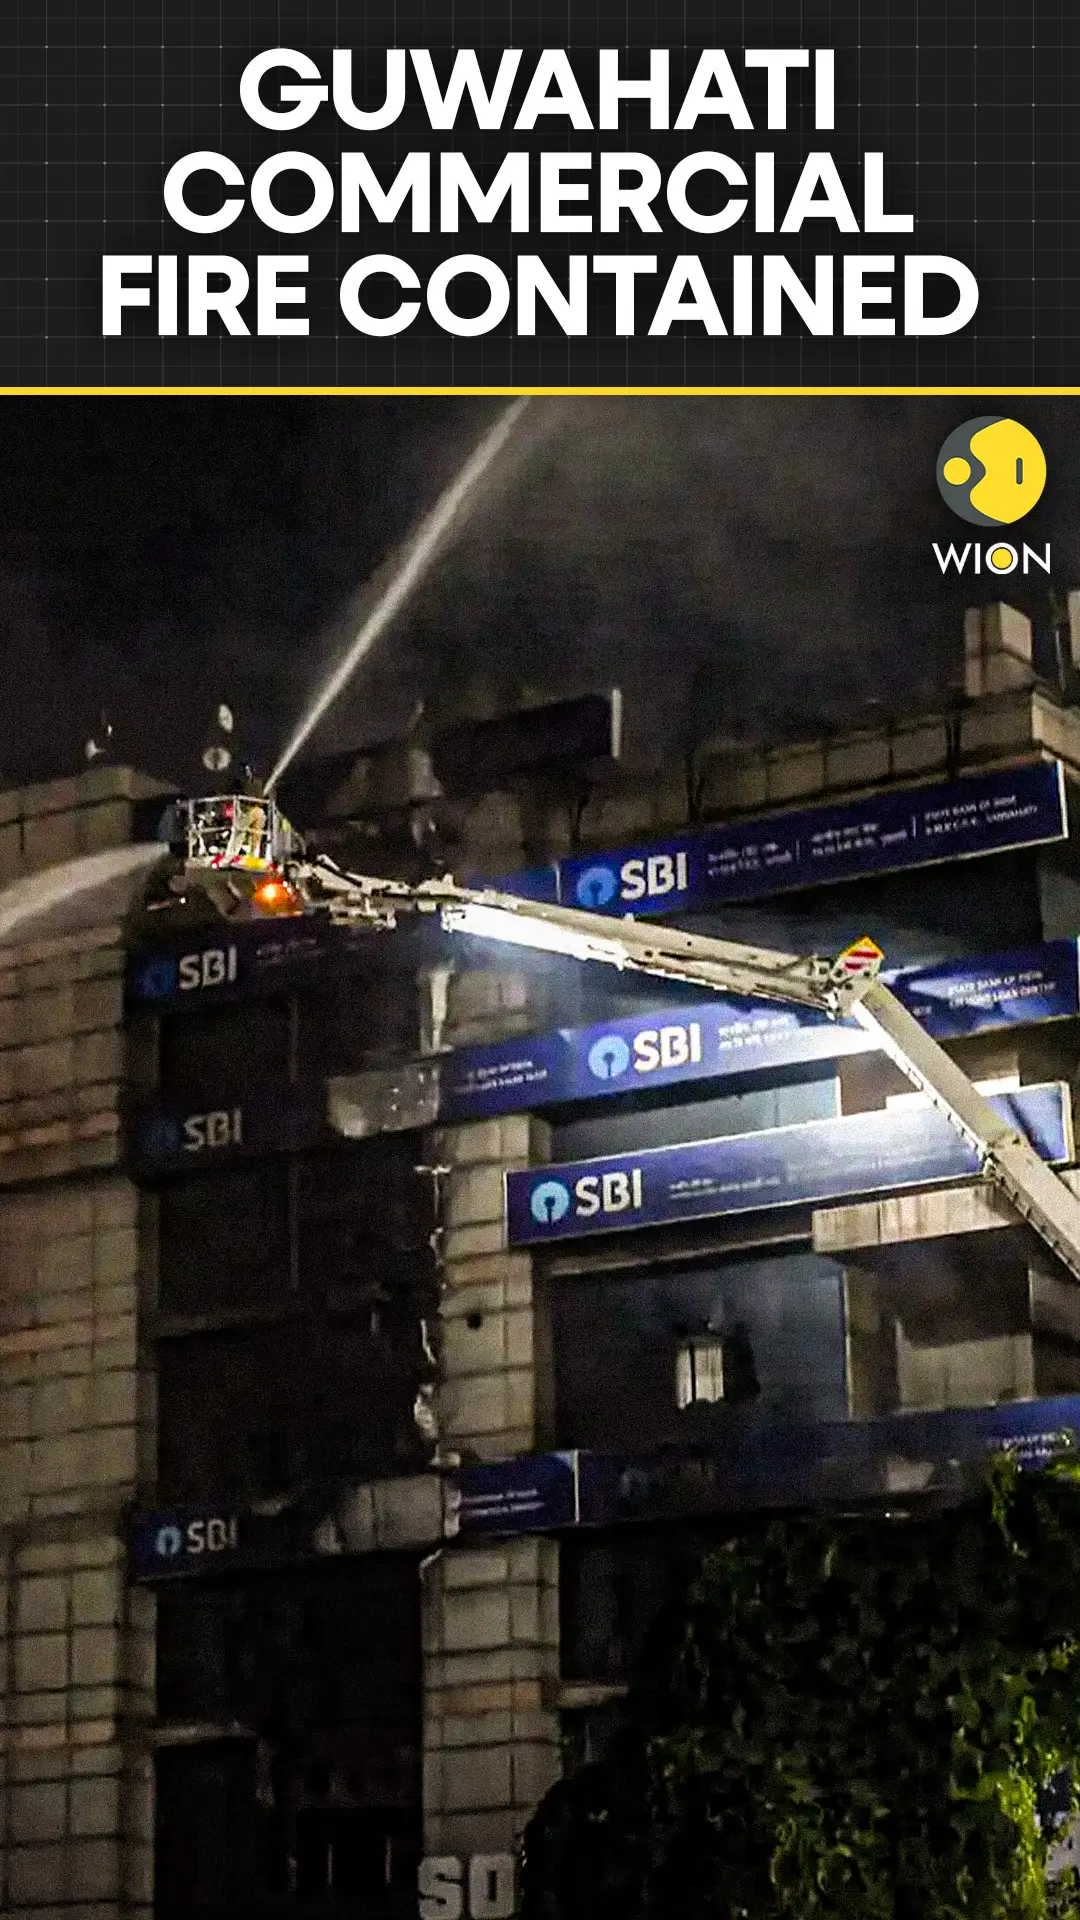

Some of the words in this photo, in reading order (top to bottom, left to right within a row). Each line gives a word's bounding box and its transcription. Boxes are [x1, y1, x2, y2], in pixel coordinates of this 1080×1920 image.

[621, 851, 689, 900] SBI
[178, 946, 238, 990] SBI
[633, 1022, 701, 1073] SBI
[183, 1104, 243, 1151] SBI
[575, 1168, 643, 1217] SBI
[186, 1517, 239, 1555] SBI
